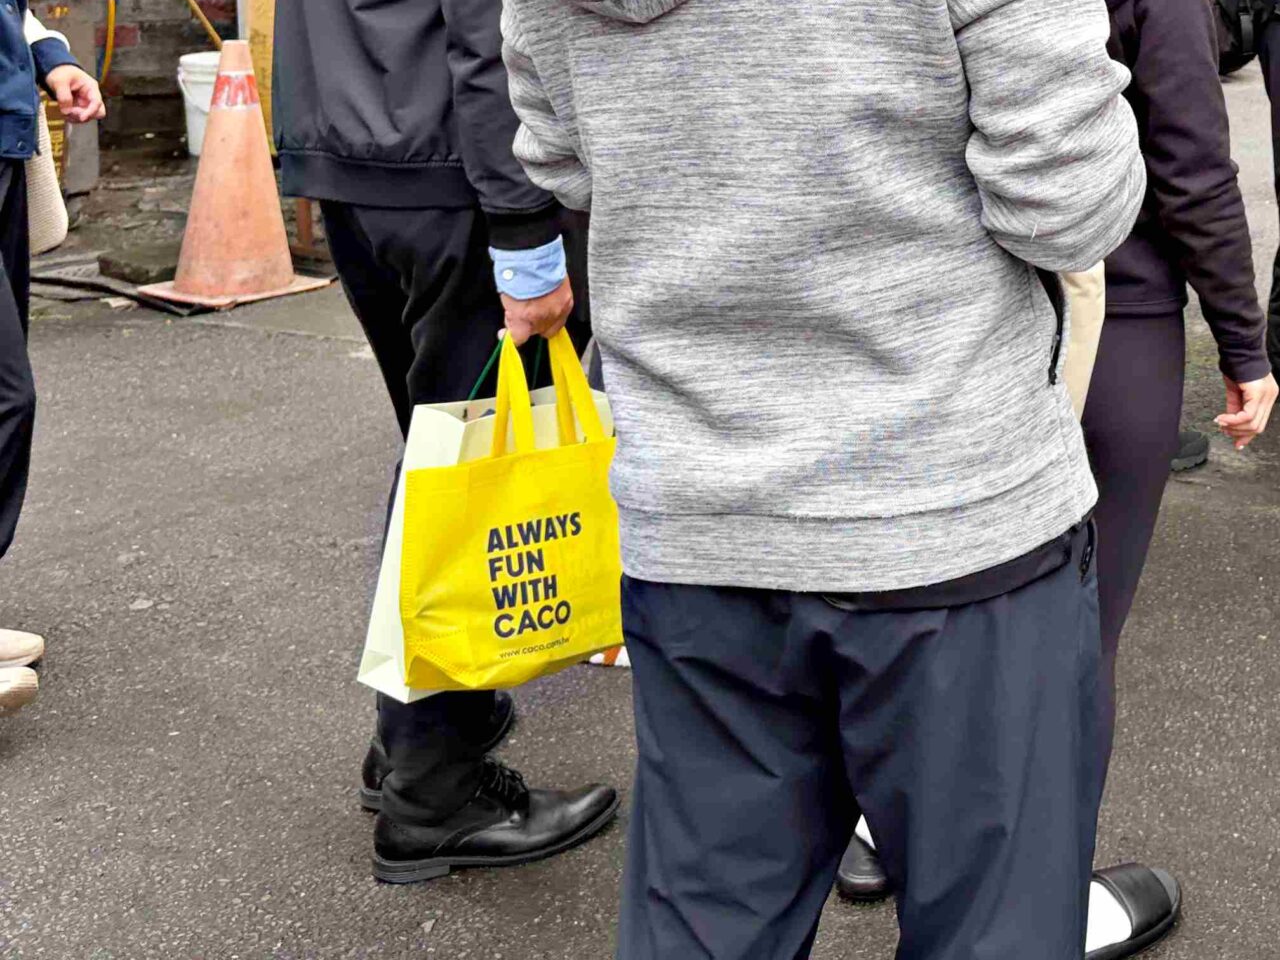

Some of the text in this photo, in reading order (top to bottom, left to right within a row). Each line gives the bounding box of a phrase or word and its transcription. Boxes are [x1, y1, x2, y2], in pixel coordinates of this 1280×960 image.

[487, 512, 582, 553] ALWAYS
[488, 548, 545, 582] FUN
[492, 574, 558, 611] WITH
[494, 600, 571, 638] CACO
